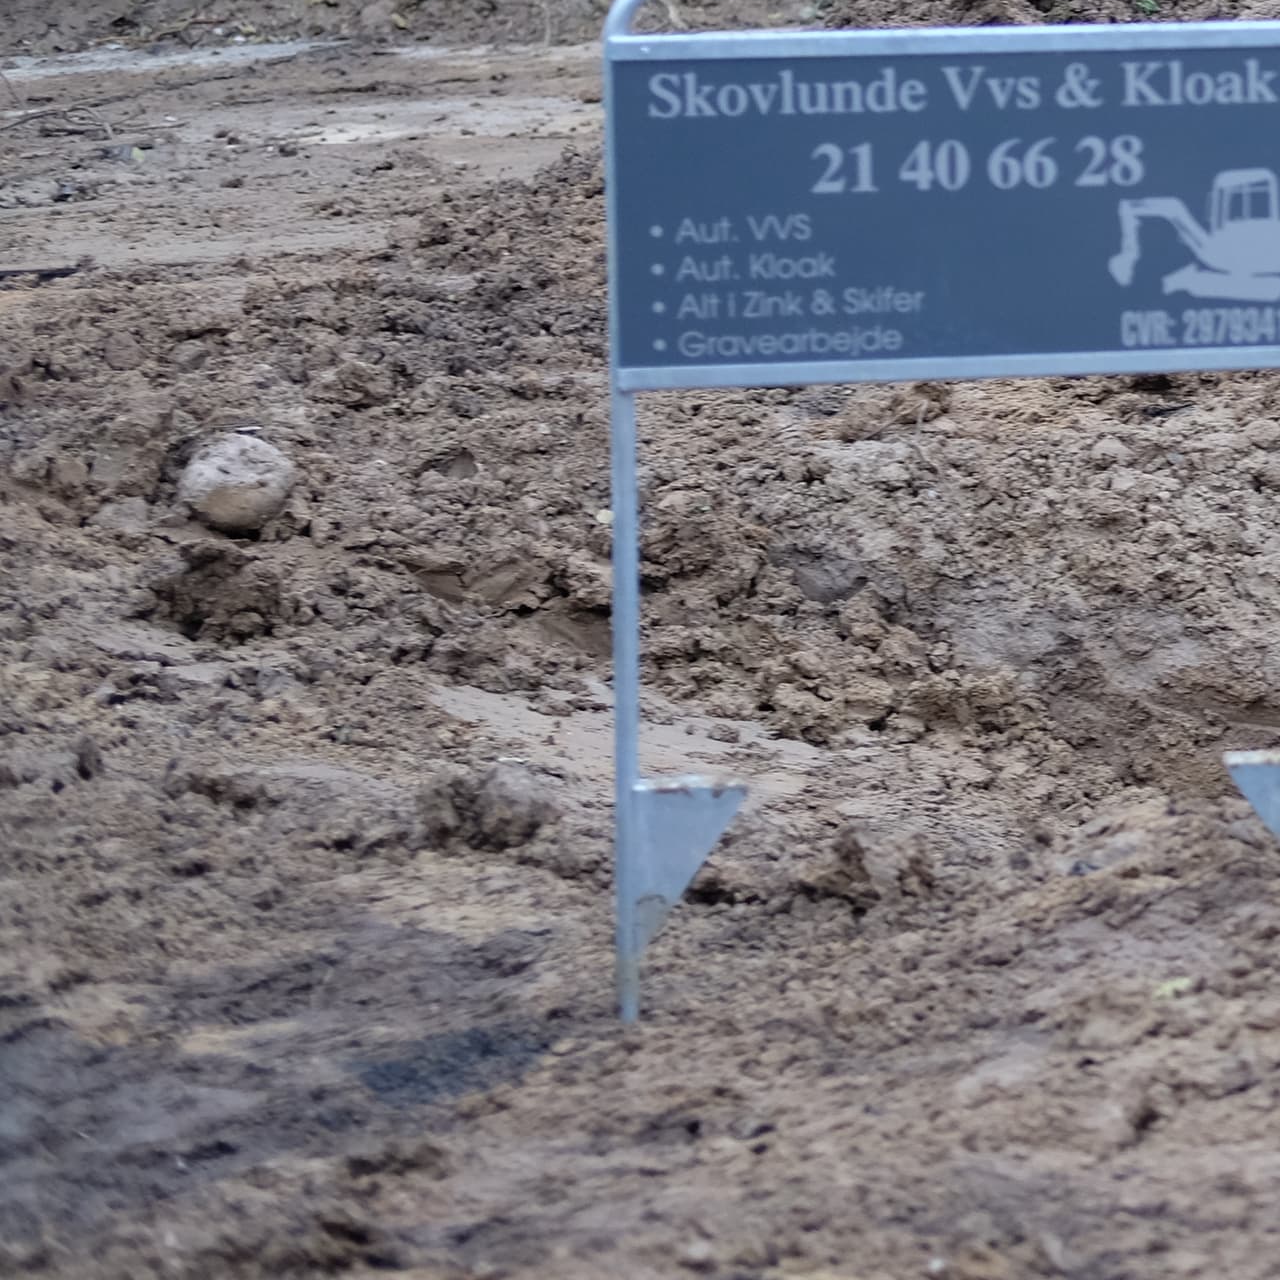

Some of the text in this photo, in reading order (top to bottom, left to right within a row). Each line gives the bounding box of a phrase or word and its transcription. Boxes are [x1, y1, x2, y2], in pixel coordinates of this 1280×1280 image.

[648, 67, 928, 118] Skovlunde
[940, 65, 1042, 111] Vvs
[1054, 62, 1103, 109] &
[1120, 57, 1278, 107] Kloak
[810, 134, 1144, 194] 21 40 66 28
[675, 213, 813, 245] Aut. VVS
[676, 251, 837, 282] Aut. Kloak
[677, 292, 722, 319] Alt
[742, 289, 804, 318] Zink
[809, 287, 836, 316] &
[842, 285, 926, 315] Skifer
[677, 325, 904, 358] Gravearbejde
